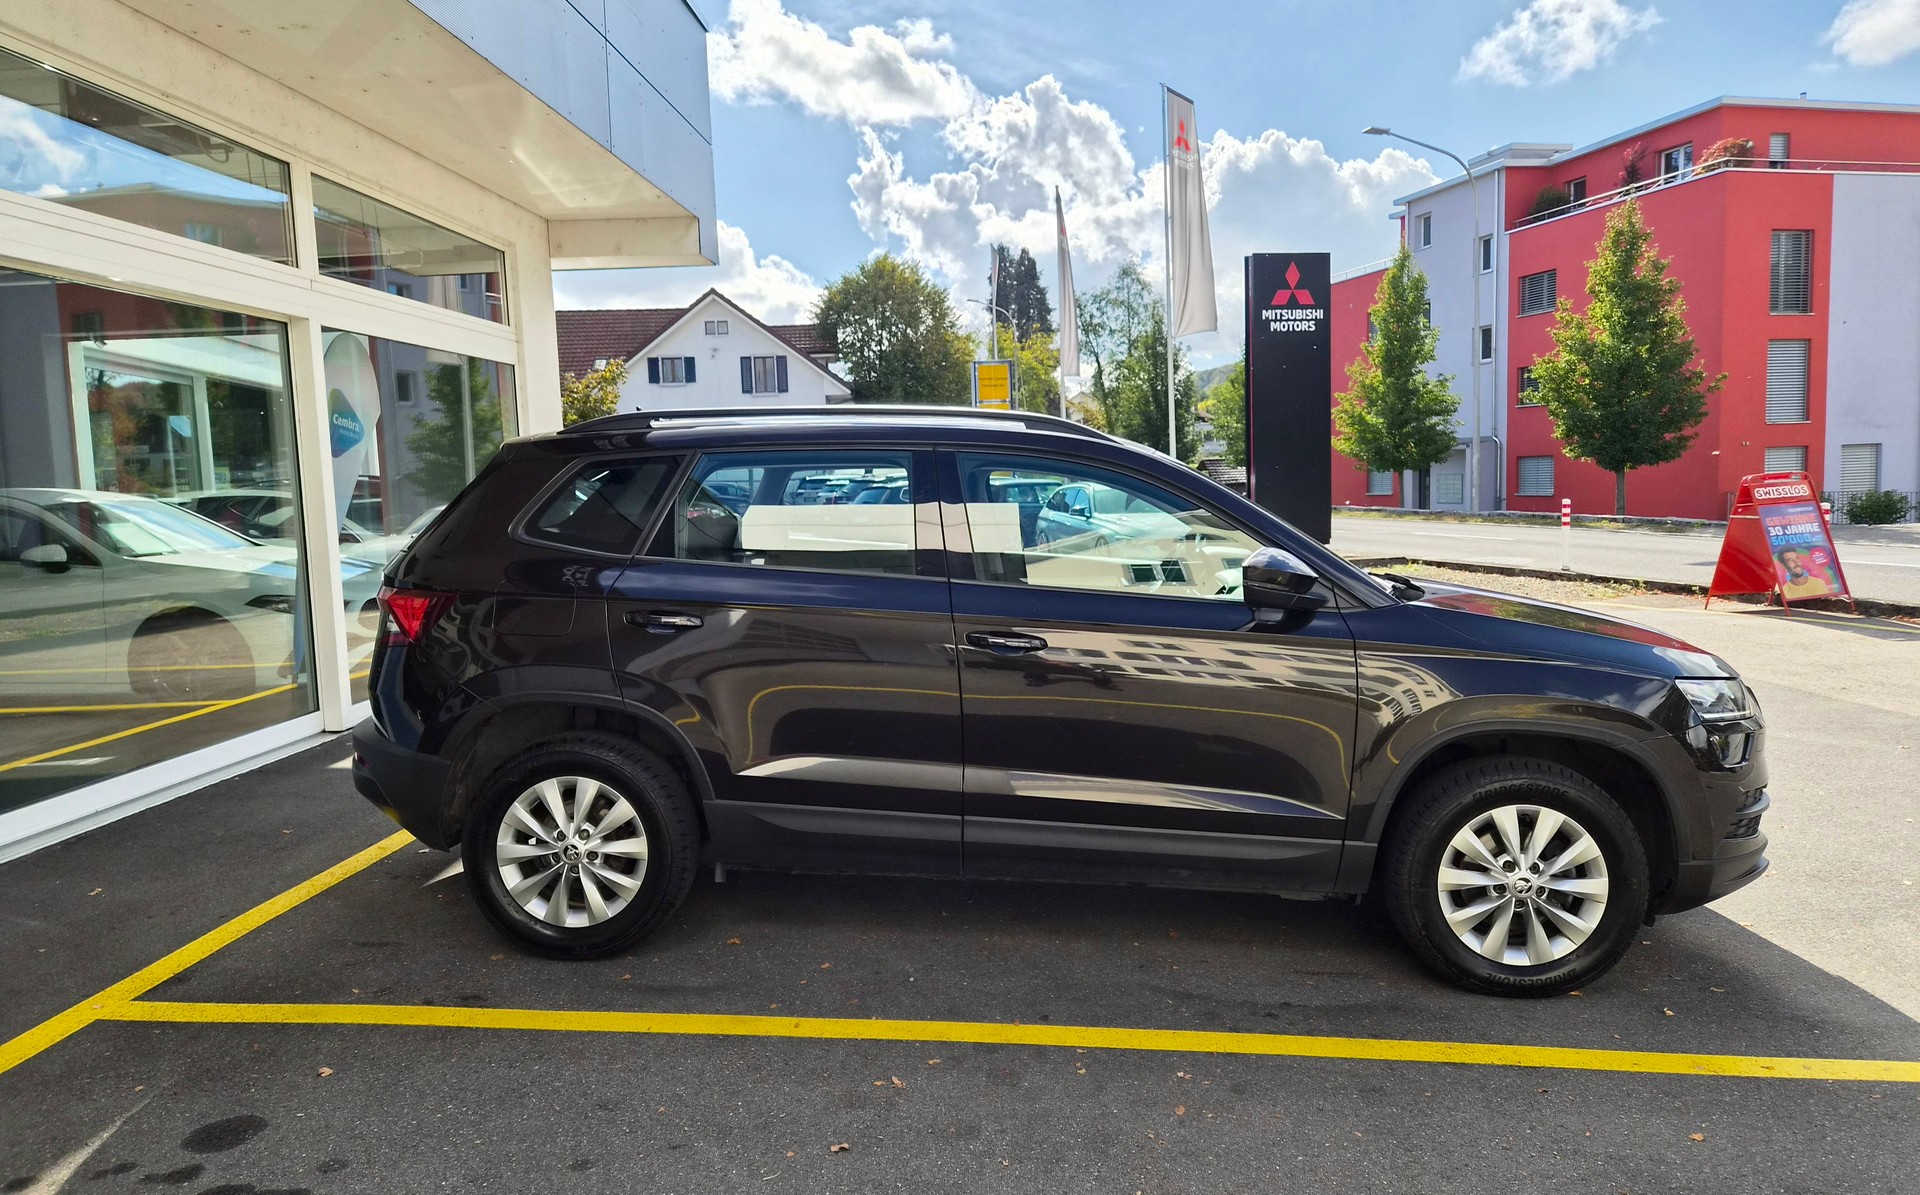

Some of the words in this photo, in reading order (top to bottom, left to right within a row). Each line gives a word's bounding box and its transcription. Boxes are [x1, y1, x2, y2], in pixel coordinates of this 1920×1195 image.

[1261, 308, 1324, 320] MITSUBISHI
[1270, 321, 1316, 332] MOTORS
[333, 413, 360, 432] Cembra
[1755, 485, 1808, 499] SWISSLOS
[1767, 525, 1784, 536] 30
[1785, 522, 1821, 535] JAHRE
